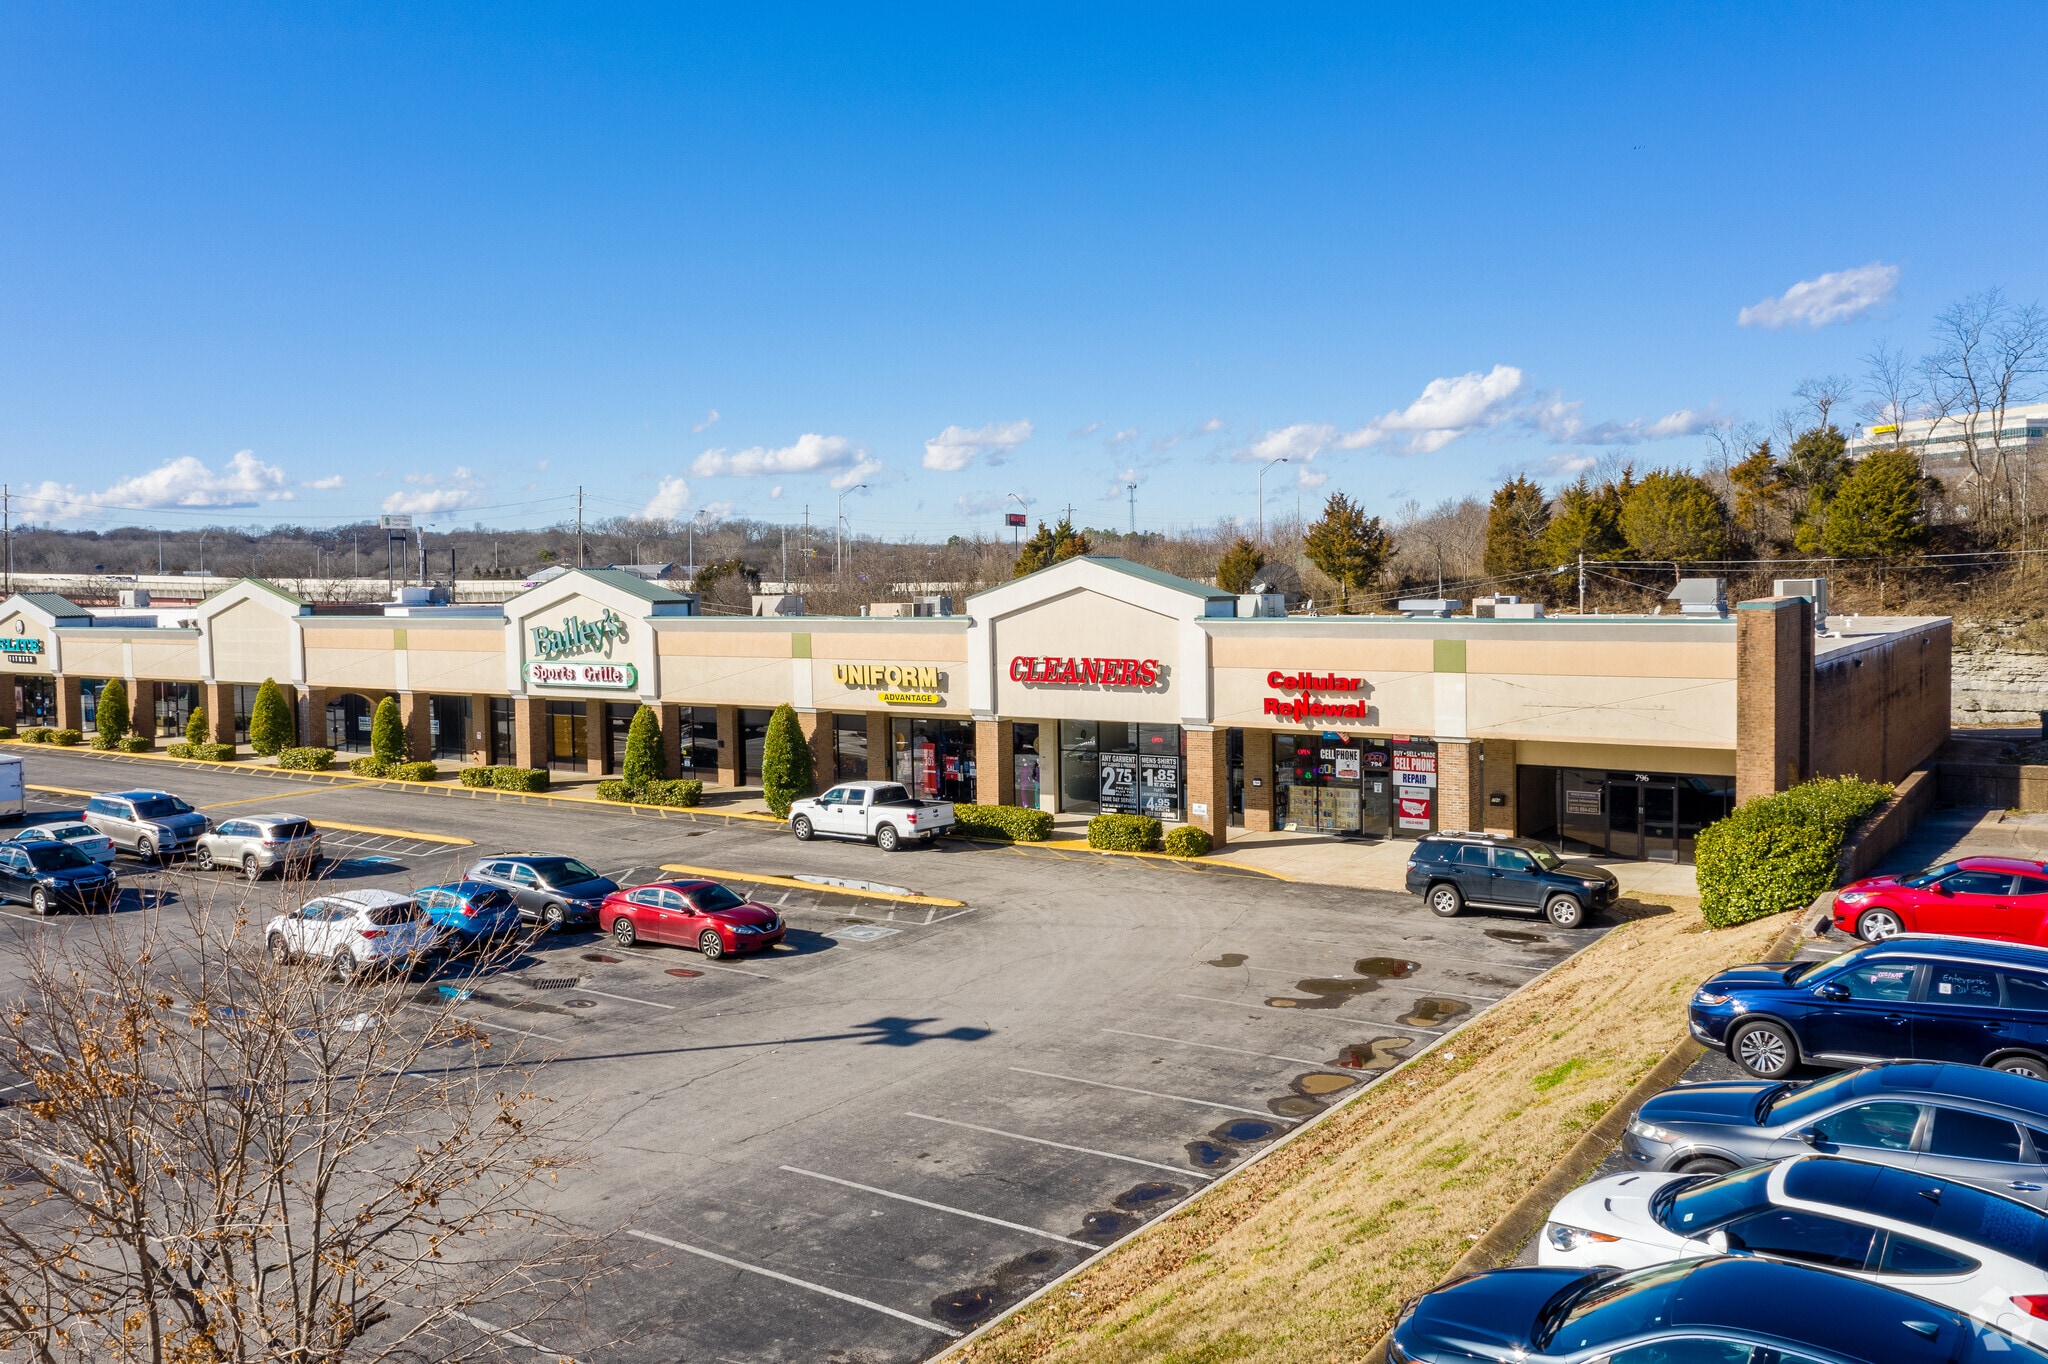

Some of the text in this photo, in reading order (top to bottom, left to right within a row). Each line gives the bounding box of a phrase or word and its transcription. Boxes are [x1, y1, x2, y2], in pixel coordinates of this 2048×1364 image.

[530, 608, 621, 656] Bailey's
[533, 664, 624, 684] Sports Grille
[832, 664, 939, 688] UNIFORM
[1009, 655, 1158, 687] CLEANERS
[1267, 671, 1362, 691] Cellular
[884, 693, 933, 702] ADVANTAGE
[1101, 754, 1135, 763] ANY GARMENT
[1320, 748, 1358, 761] CELL PHONE
[1364, 753, 1386, 763] OPEN
[1394, 757, 1436, 771] CELL PHONE
[1116, 768, 1133, 783] 75
[1402, 773, 1427, 785] REPAIR
[1635, 774, 1649, 782] 796
[1146, 797, 1170, 811] 4.95
